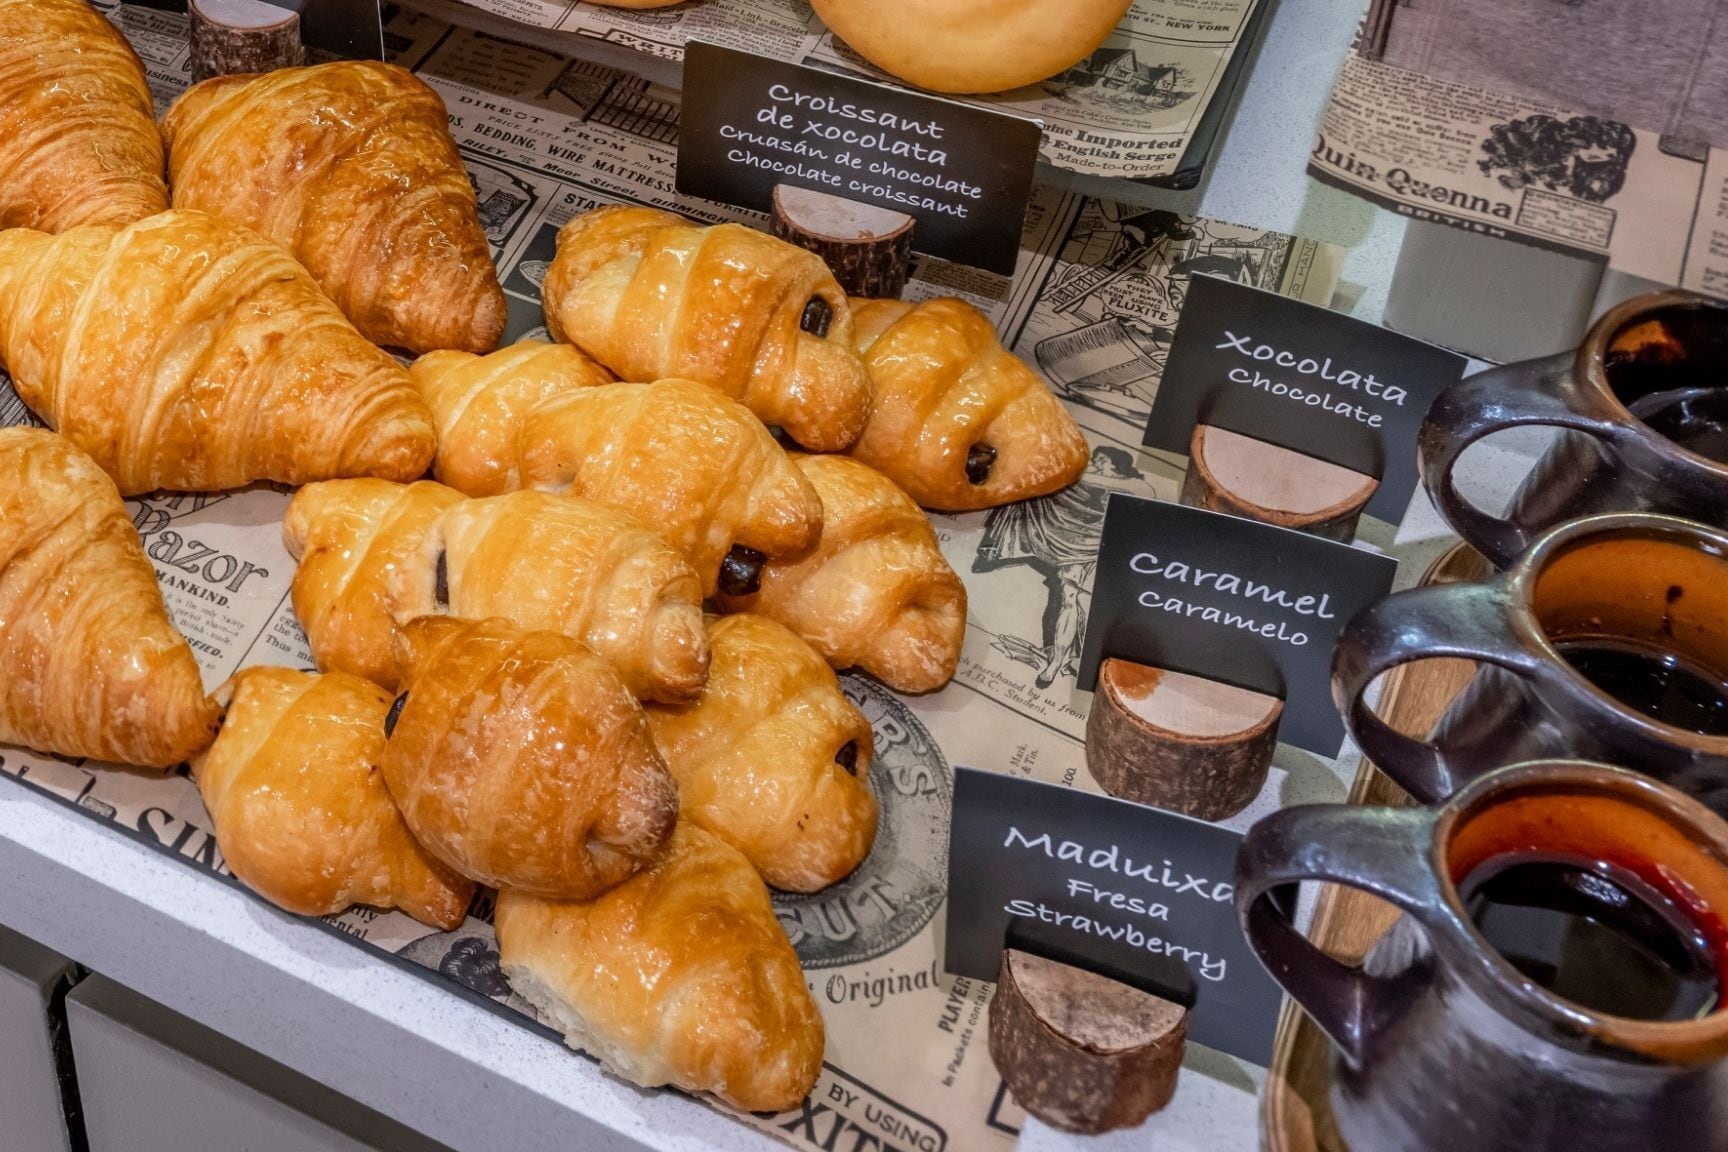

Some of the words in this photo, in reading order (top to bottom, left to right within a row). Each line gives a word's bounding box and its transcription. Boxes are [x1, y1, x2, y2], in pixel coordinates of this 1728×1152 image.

[1166, 20, 1194, 31] NEW
[1198, 24, 1231, 33] YORK
[459, 95, 545, 124] DIRECT
[563, 125, 628, 152] FROM
[768, 83, 946, 141] Croissant
[547, 144, 586, 165] WIRE
[756, 104, 794, 130] de
[801, 118, 948, 167] xocolata
[1052, 138, 1121, 160] English
[1123, 151, 1177, 162] Serge
[1074, 130, 1184, 150] Imported
[834, 150, 862, 169] de
[868, 161, 983, 200] chocolate
[1055, 152, 1164, 172] Made-to-Order
[848, 179, 969, 220] croissant
[1107, 298, 1170, 323] FLUXITE
[1109, 284, 1135, 298] MUST
[1138, 293, 1164, 306] HAVE
[1126, 283, 1155, 295] THEY
[1131, 297, 1163, 310] USING
[1215, 329, 1409, 407] Xocolata
[1129, 552, 1335, 620] Caramel
[274, 623, 291, 636] the
[1137, 591, 1309, 647] Caramelo
[973, 663, 1027, 692] purchased
[1028, 687, 1041, 700] by
[1044, 698, 1057, 707] us
[1058, 703, 1086, 721] from
[1004, 689, 1048, 715] Student.
[1003, 826, 1234, 905] Maduixa
[1067, 878, 1170, 922] Fresa
[1003, 899, 1227, 982] Strawberry
[825, 959, 942, 1008] Original
[947, 1027, 974, 1075] Packets
[829, 1083, 859, 1110] BY
[864, 1108, 938, 1152] USING
